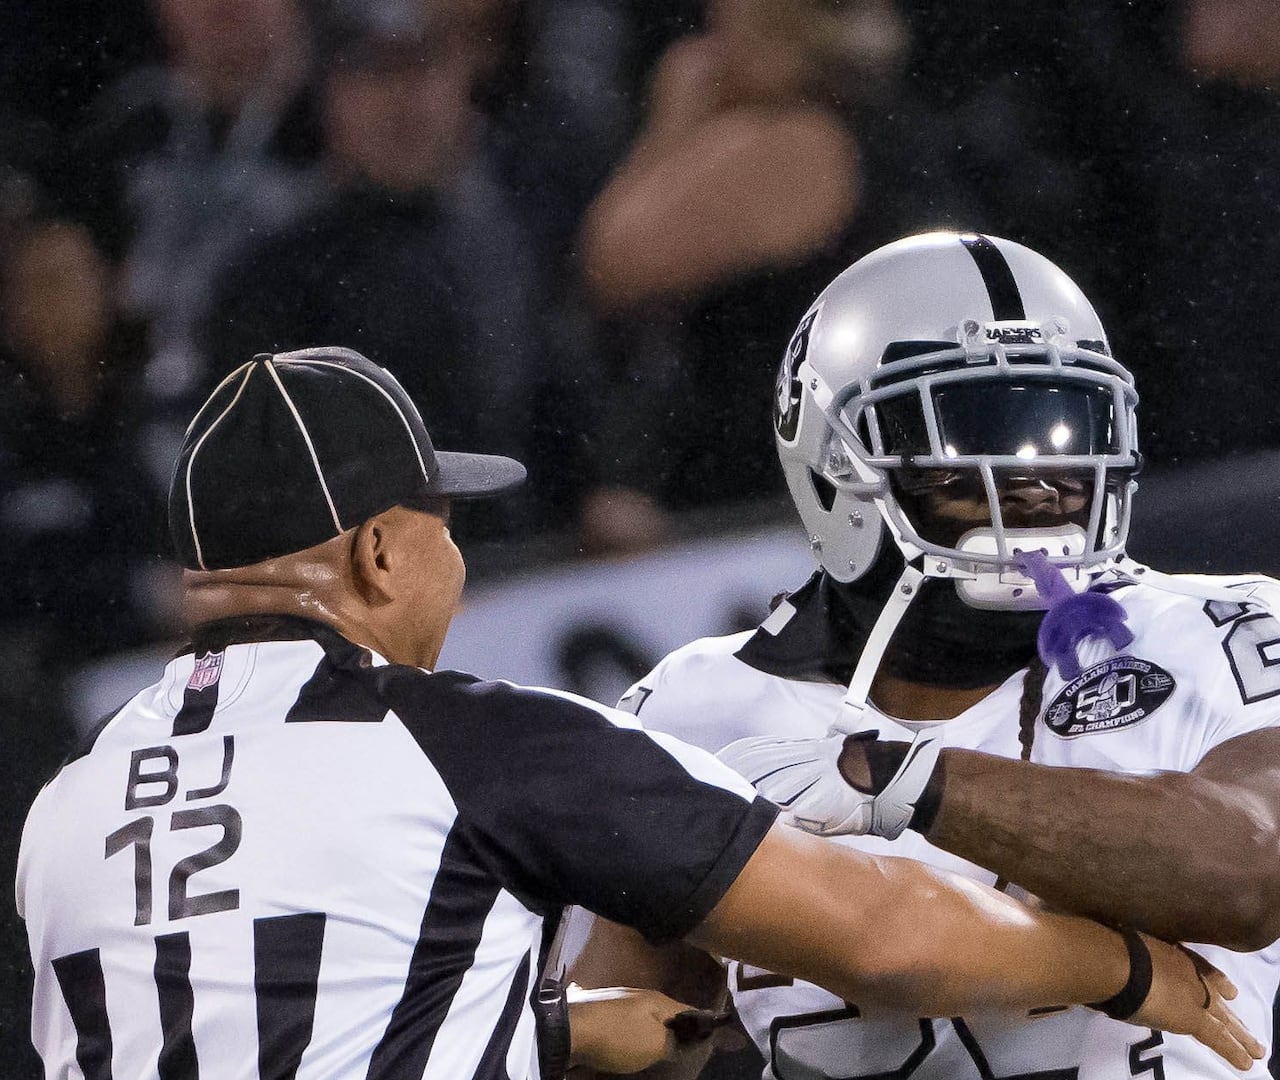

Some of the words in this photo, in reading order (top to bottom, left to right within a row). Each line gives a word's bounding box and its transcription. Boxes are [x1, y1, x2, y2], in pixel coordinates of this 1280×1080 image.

[1111, 660, 1152, 673] RAIDERS
[1085, 707, 1145, 731] CHAMPIONS
[124, 735, 234, 811] BJ
[104, 804, 243, 926] 12
